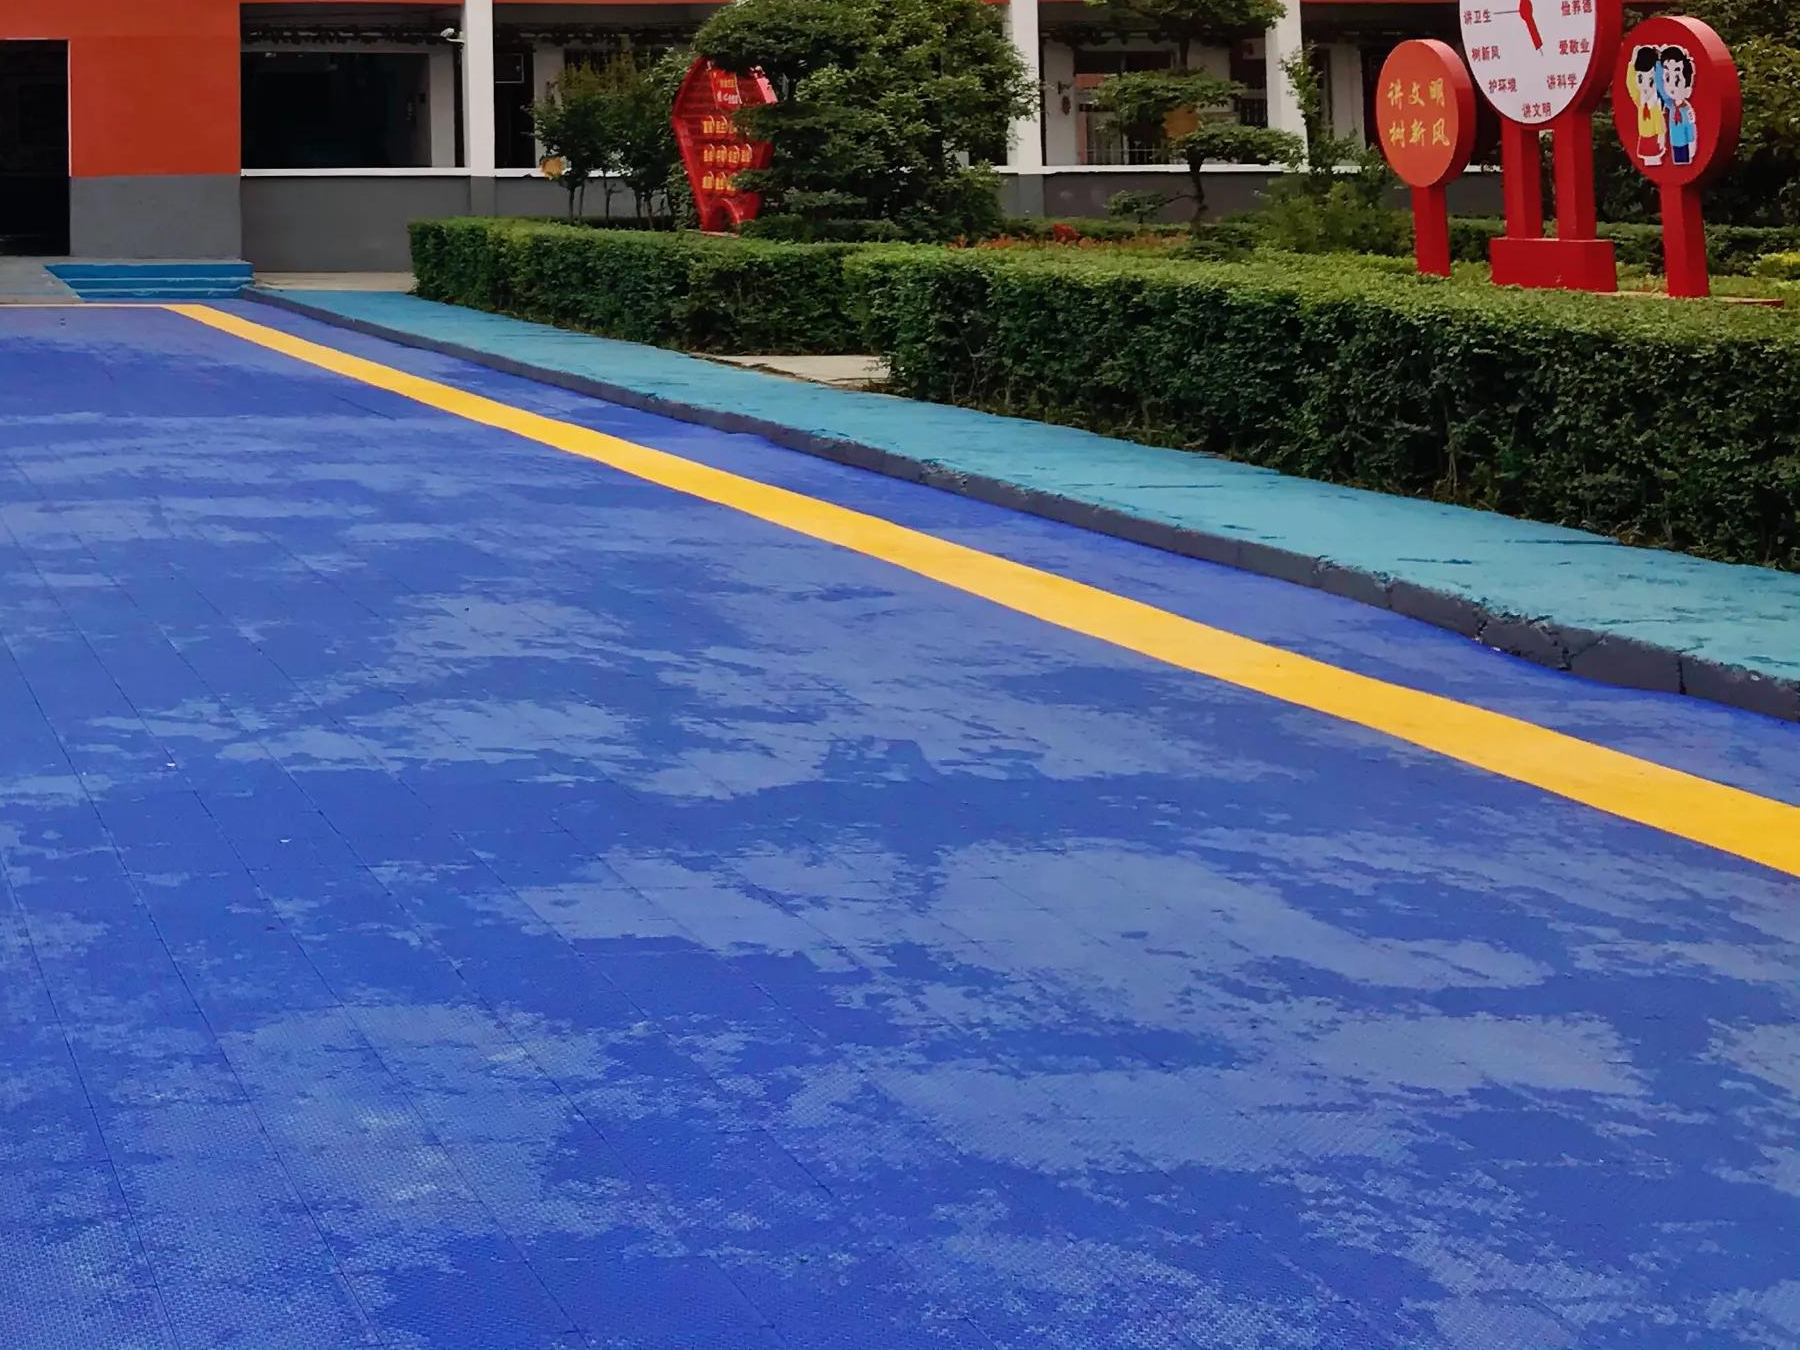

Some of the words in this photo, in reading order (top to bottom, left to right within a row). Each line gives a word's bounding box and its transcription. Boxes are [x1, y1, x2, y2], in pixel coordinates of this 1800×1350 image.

[1463, 9, 1492, 25] 讲卫生
[1471, 45, 1501, 62] 树新风
[1488, 77, 1518, 94] 护环境
[1546, 73, 1578, 90] 讲科学
[1387, 77, 1445, 110] 讲文明
[1521, 102, 1552, 118] 讲文明
[1388, 118, 1450, 148] 树新风
